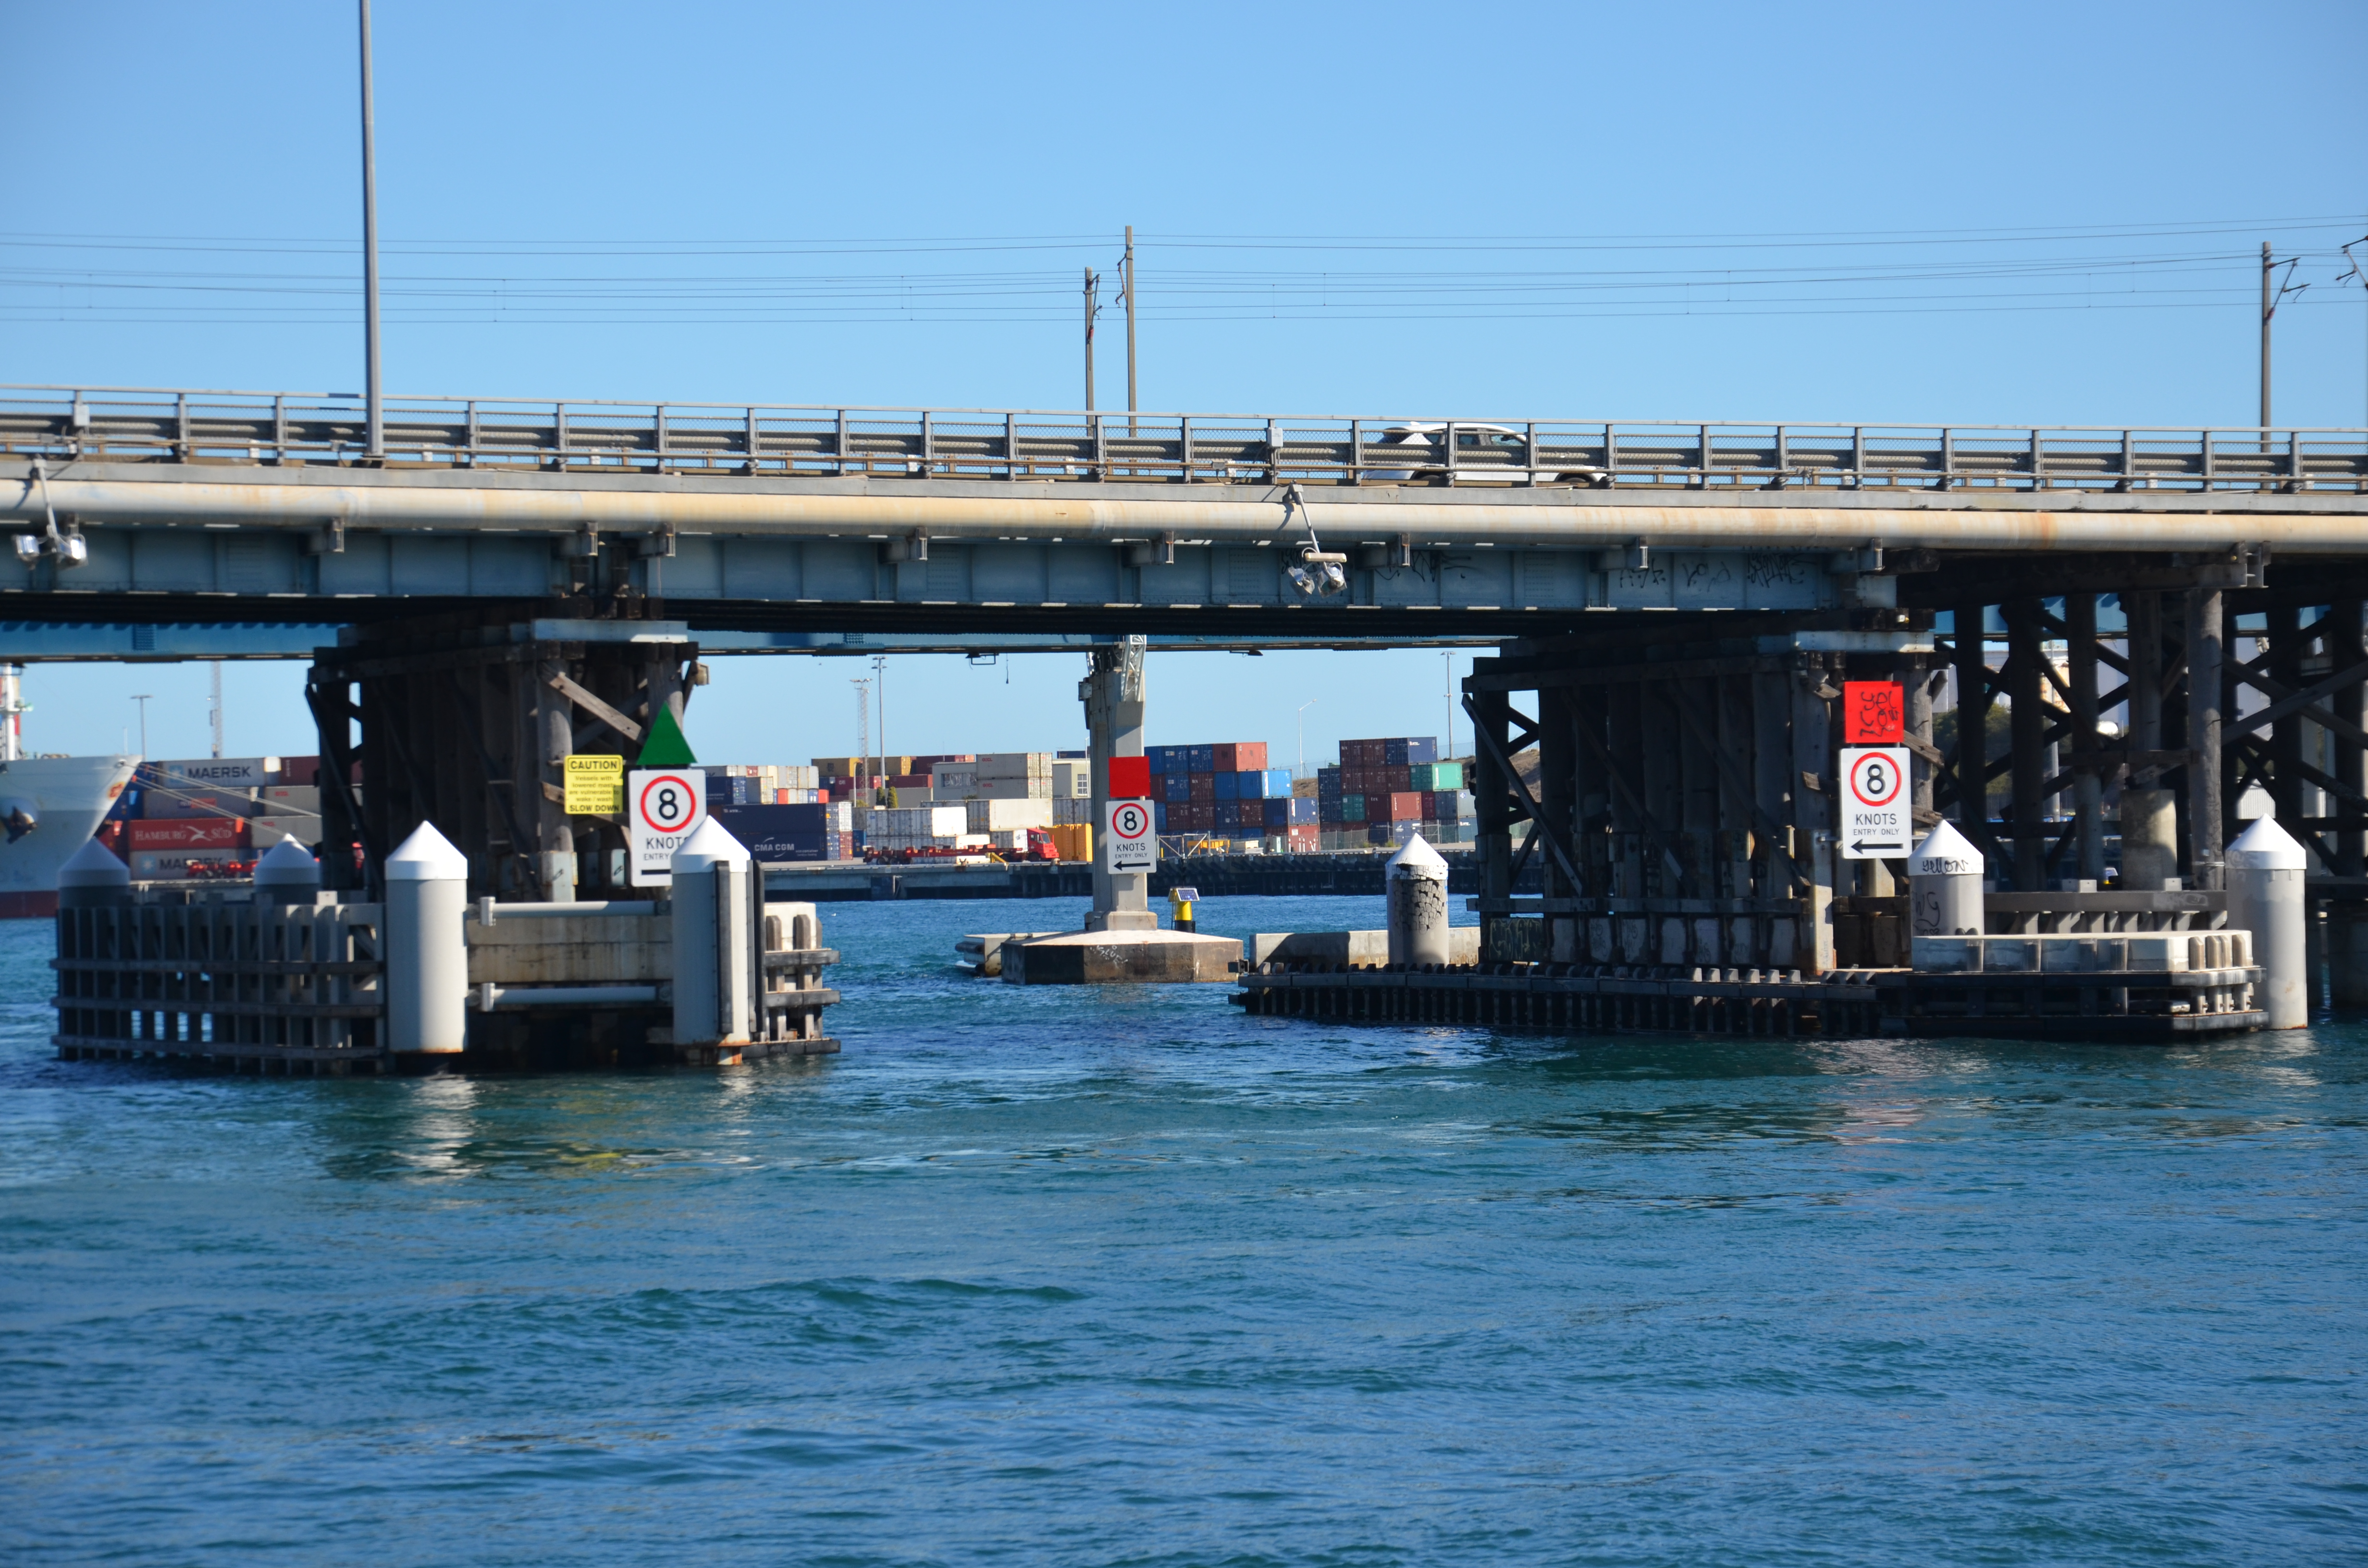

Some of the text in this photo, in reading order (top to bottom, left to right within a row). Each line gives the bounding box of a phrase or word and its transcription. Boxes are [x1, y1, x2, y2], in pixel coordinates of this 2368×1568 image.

[570, 760, 617, 769] CAUTION
[187, 766, 251, 779] MAERSK
[1867, 764, 1885, 794] 8
[658, 788, 678, 820] 8
[1124, 810, 1137, 831] 8
[1855, 813, 1897, 826] KNOTS
[135, 828, 232, 841] HAMBURG SÜD
[646, 837, 689, 849] KNOT
[1116, 843, 1146, 852] KNOTS
